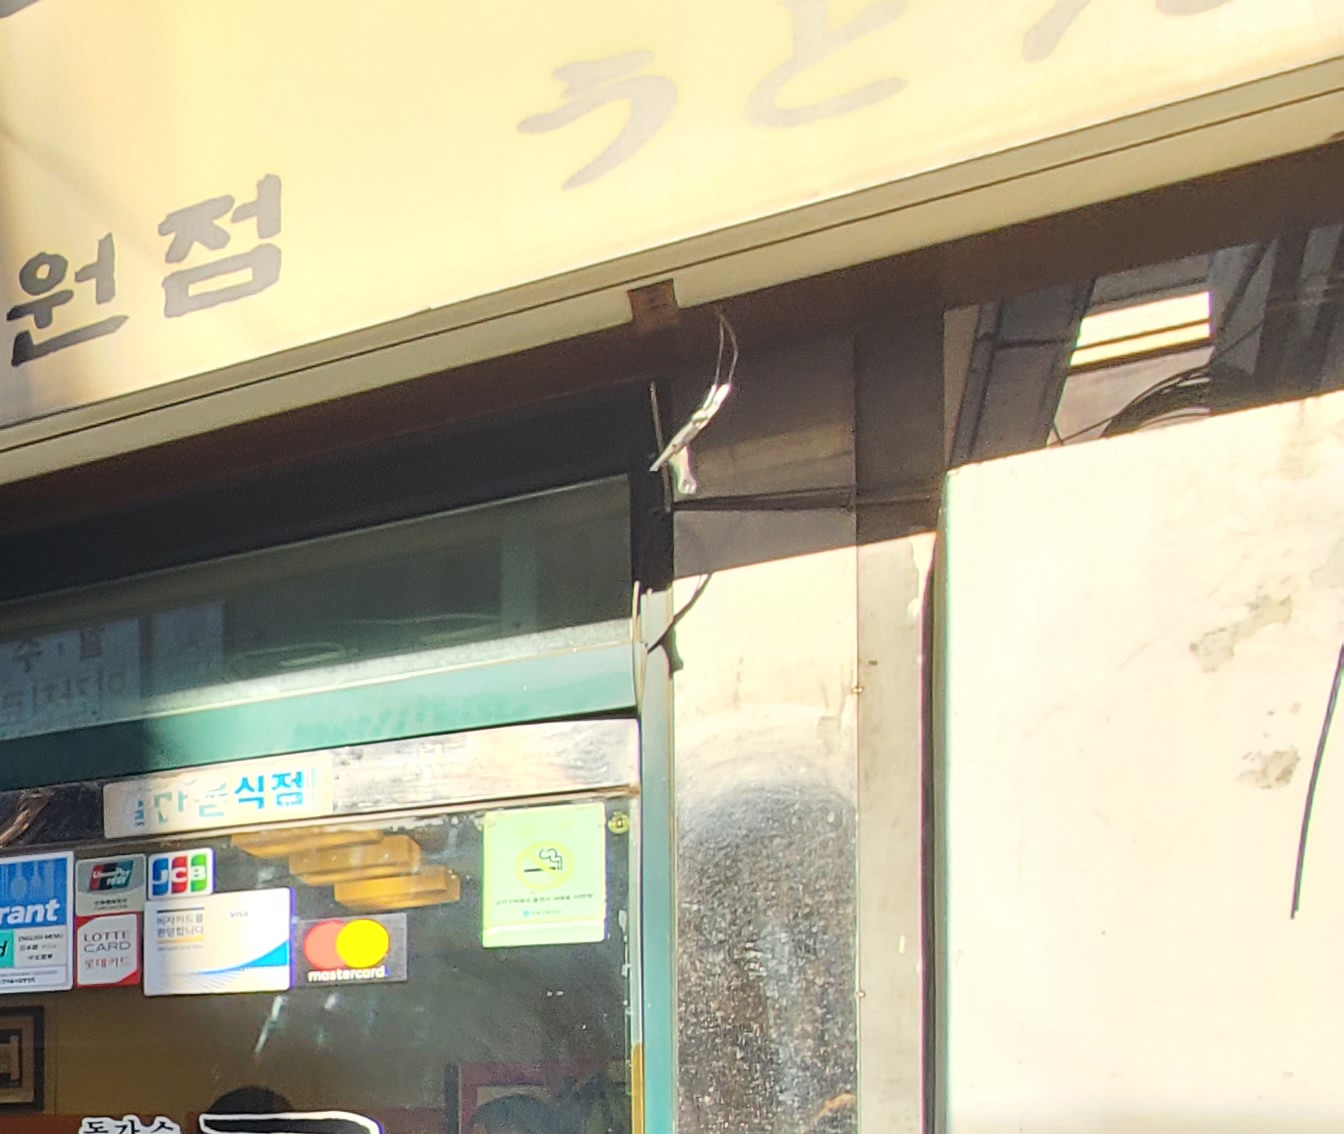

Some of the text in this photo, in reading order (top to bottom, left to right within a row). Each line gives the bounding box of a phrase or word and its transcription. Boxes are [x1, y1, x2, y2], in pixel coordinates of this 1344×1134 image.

[152, 858, 207, 892] JCB
[83, 931, 129, 942] LOTTE
[83, 940, 131, 953] CARD
[84, 956, 130, 970] 롯데카드
[307, 966, 388, 983] mastercard
